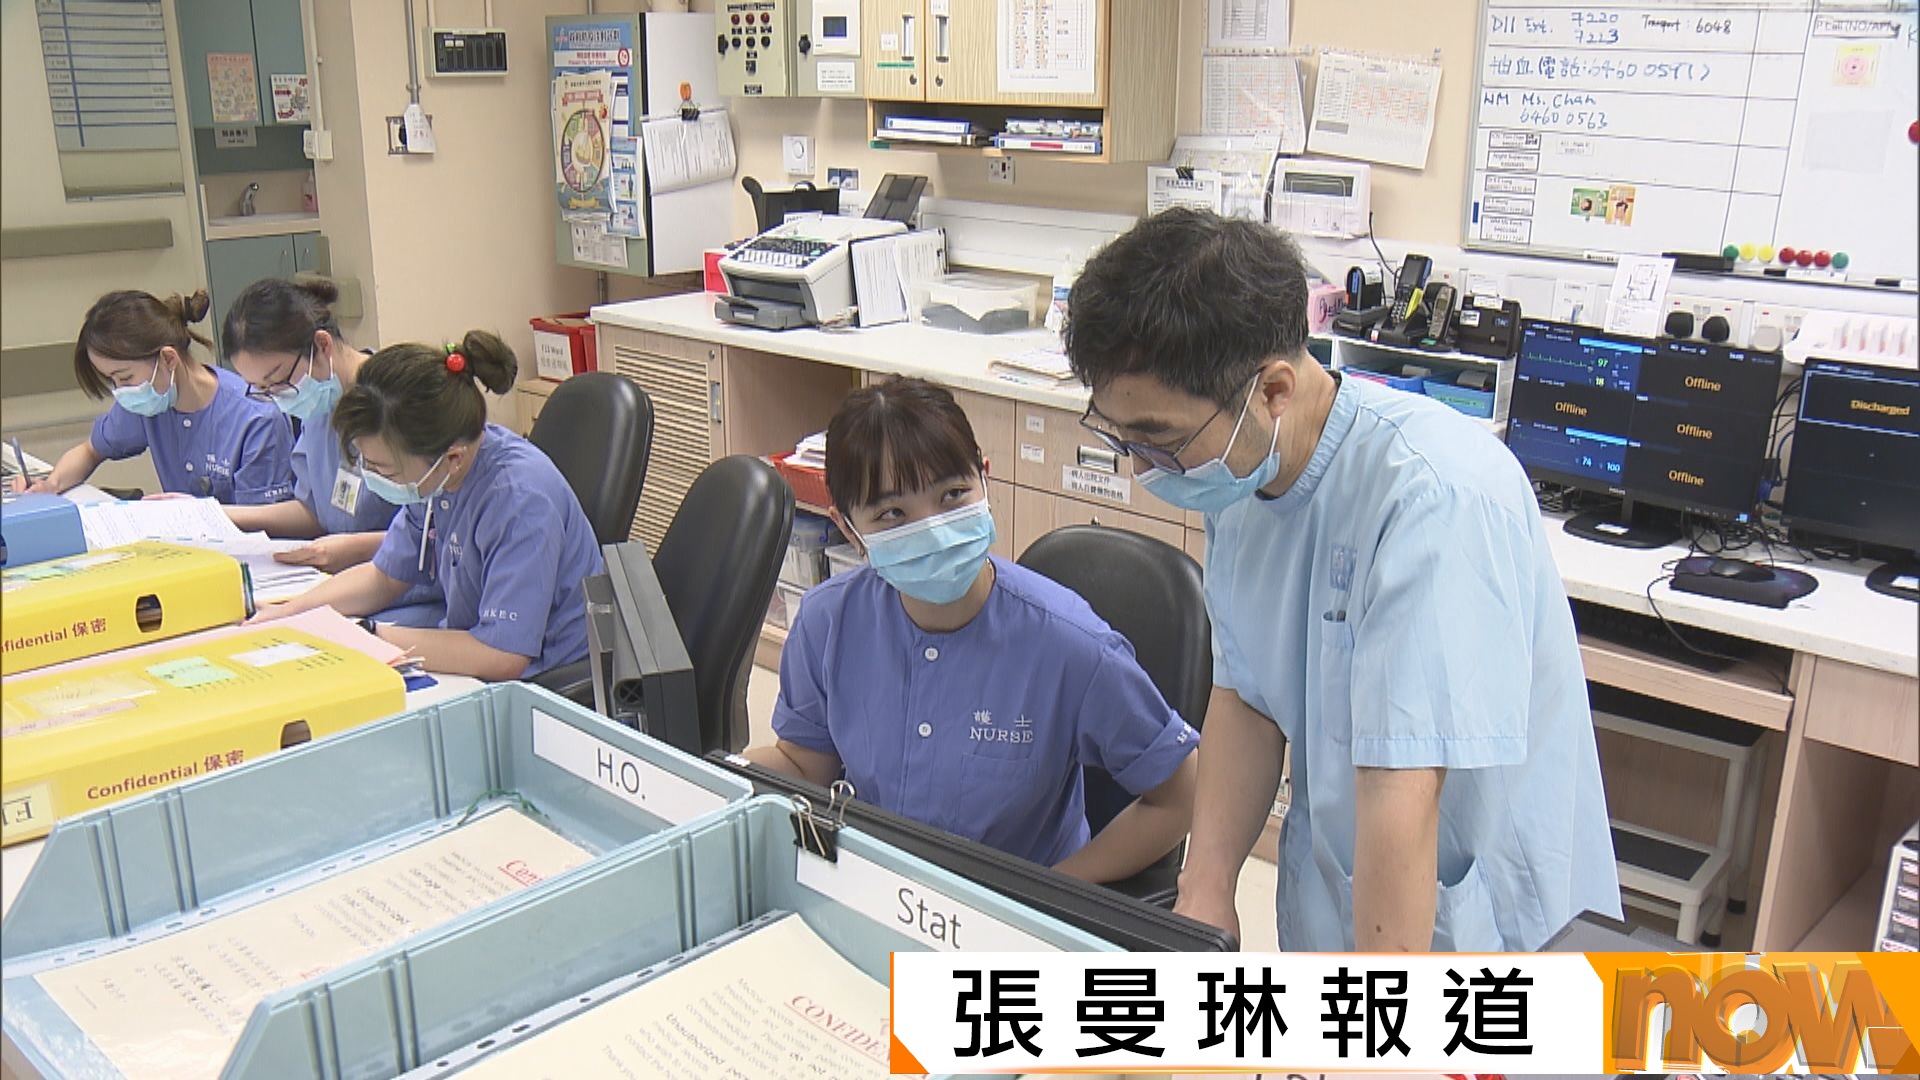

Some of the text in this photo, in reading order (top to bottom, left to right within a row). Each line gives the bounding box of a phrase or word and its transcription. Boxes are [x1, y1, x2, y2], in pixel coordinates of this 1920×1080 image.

[1571, 12, 1619, 27] 7220
[1696, 17, 1732, 34] 6048
[1685, 375, 1722, 392] Offline
[1555, 401, 1588, 417] Offline
[1850, 399, 1911, 416] Discharged
[1676, 423, 1713, 440] Offline
[1582, 456, 1621, 473] 74 100
[1668, 469, 1705, 486] Offline
[72, 618, 107, 638] 保密
[969, 726, 1034, 744] NURSE
[87, 761, 199, 800] Confidential
[597, 748, 646, 801] H.O.
[897, 887, 962, 950] Stat
